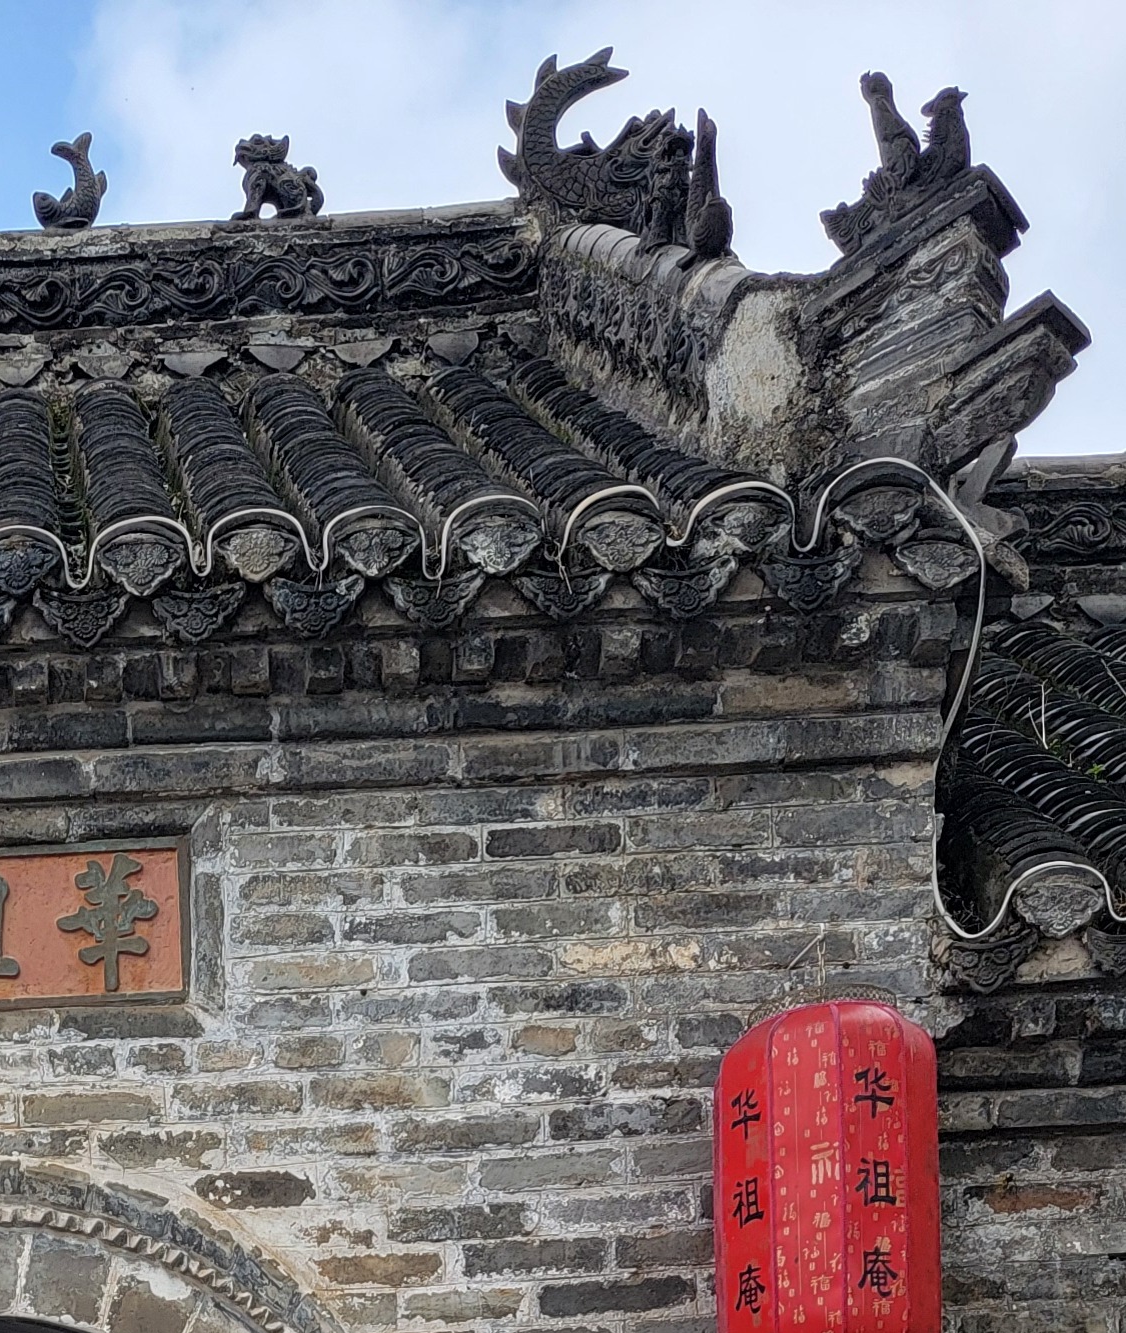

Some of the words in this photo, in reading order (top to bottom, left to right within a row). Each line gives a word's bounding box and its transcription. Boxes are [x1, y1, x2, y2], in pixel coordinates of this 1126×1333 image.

[731, 1088, 766, 1314] 华祖庵
[854, 1067, 898, 1298] 华祖庵
